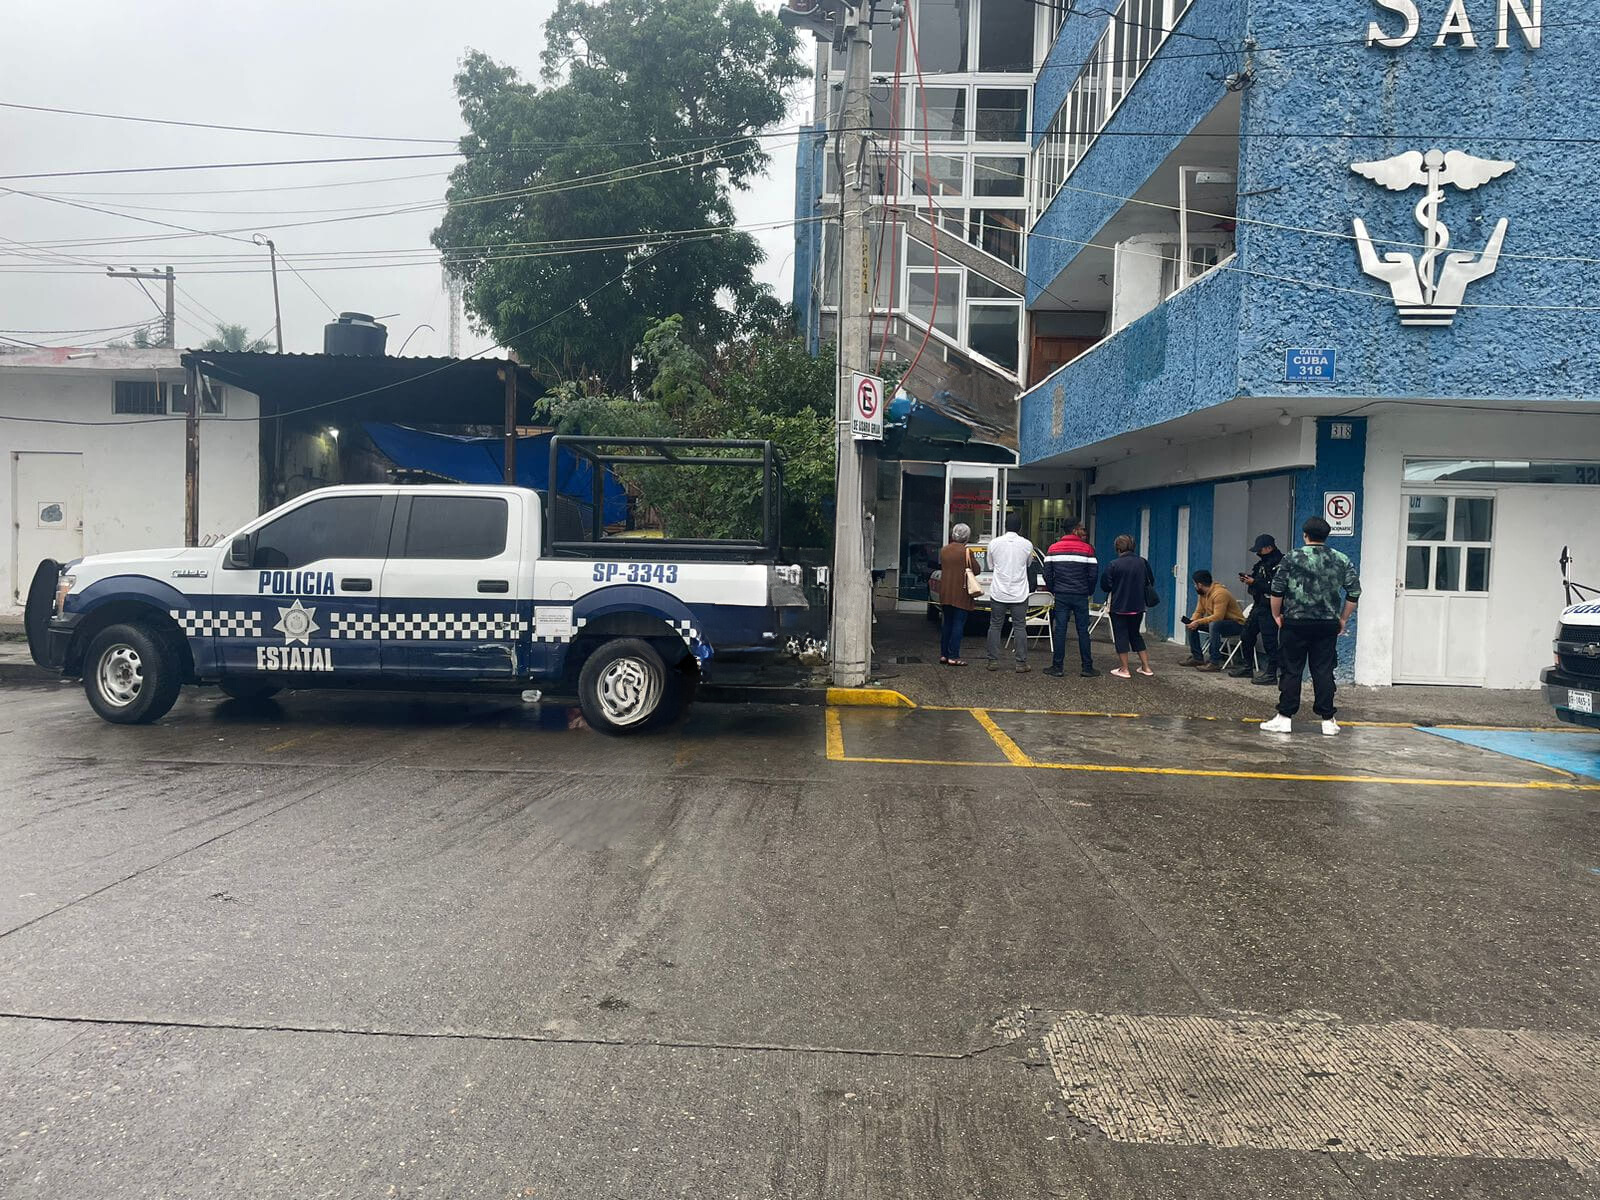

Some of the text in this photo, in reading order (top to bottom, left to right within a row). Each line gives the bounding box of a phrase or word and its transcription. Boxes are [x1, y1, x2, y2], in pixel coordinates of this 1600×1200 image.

[1367, 0, 1542, 49] SAN
[1293, 356, 1329, 365] CUBA
[1299, 366, 1322, 375] 318
[1575, 467, 1600, 484] 32
[258, 571, 335, 595] POLICIA
[592, 563, 678, 584] SP-3343
[256, 646, 335, 672] ESTATAL
